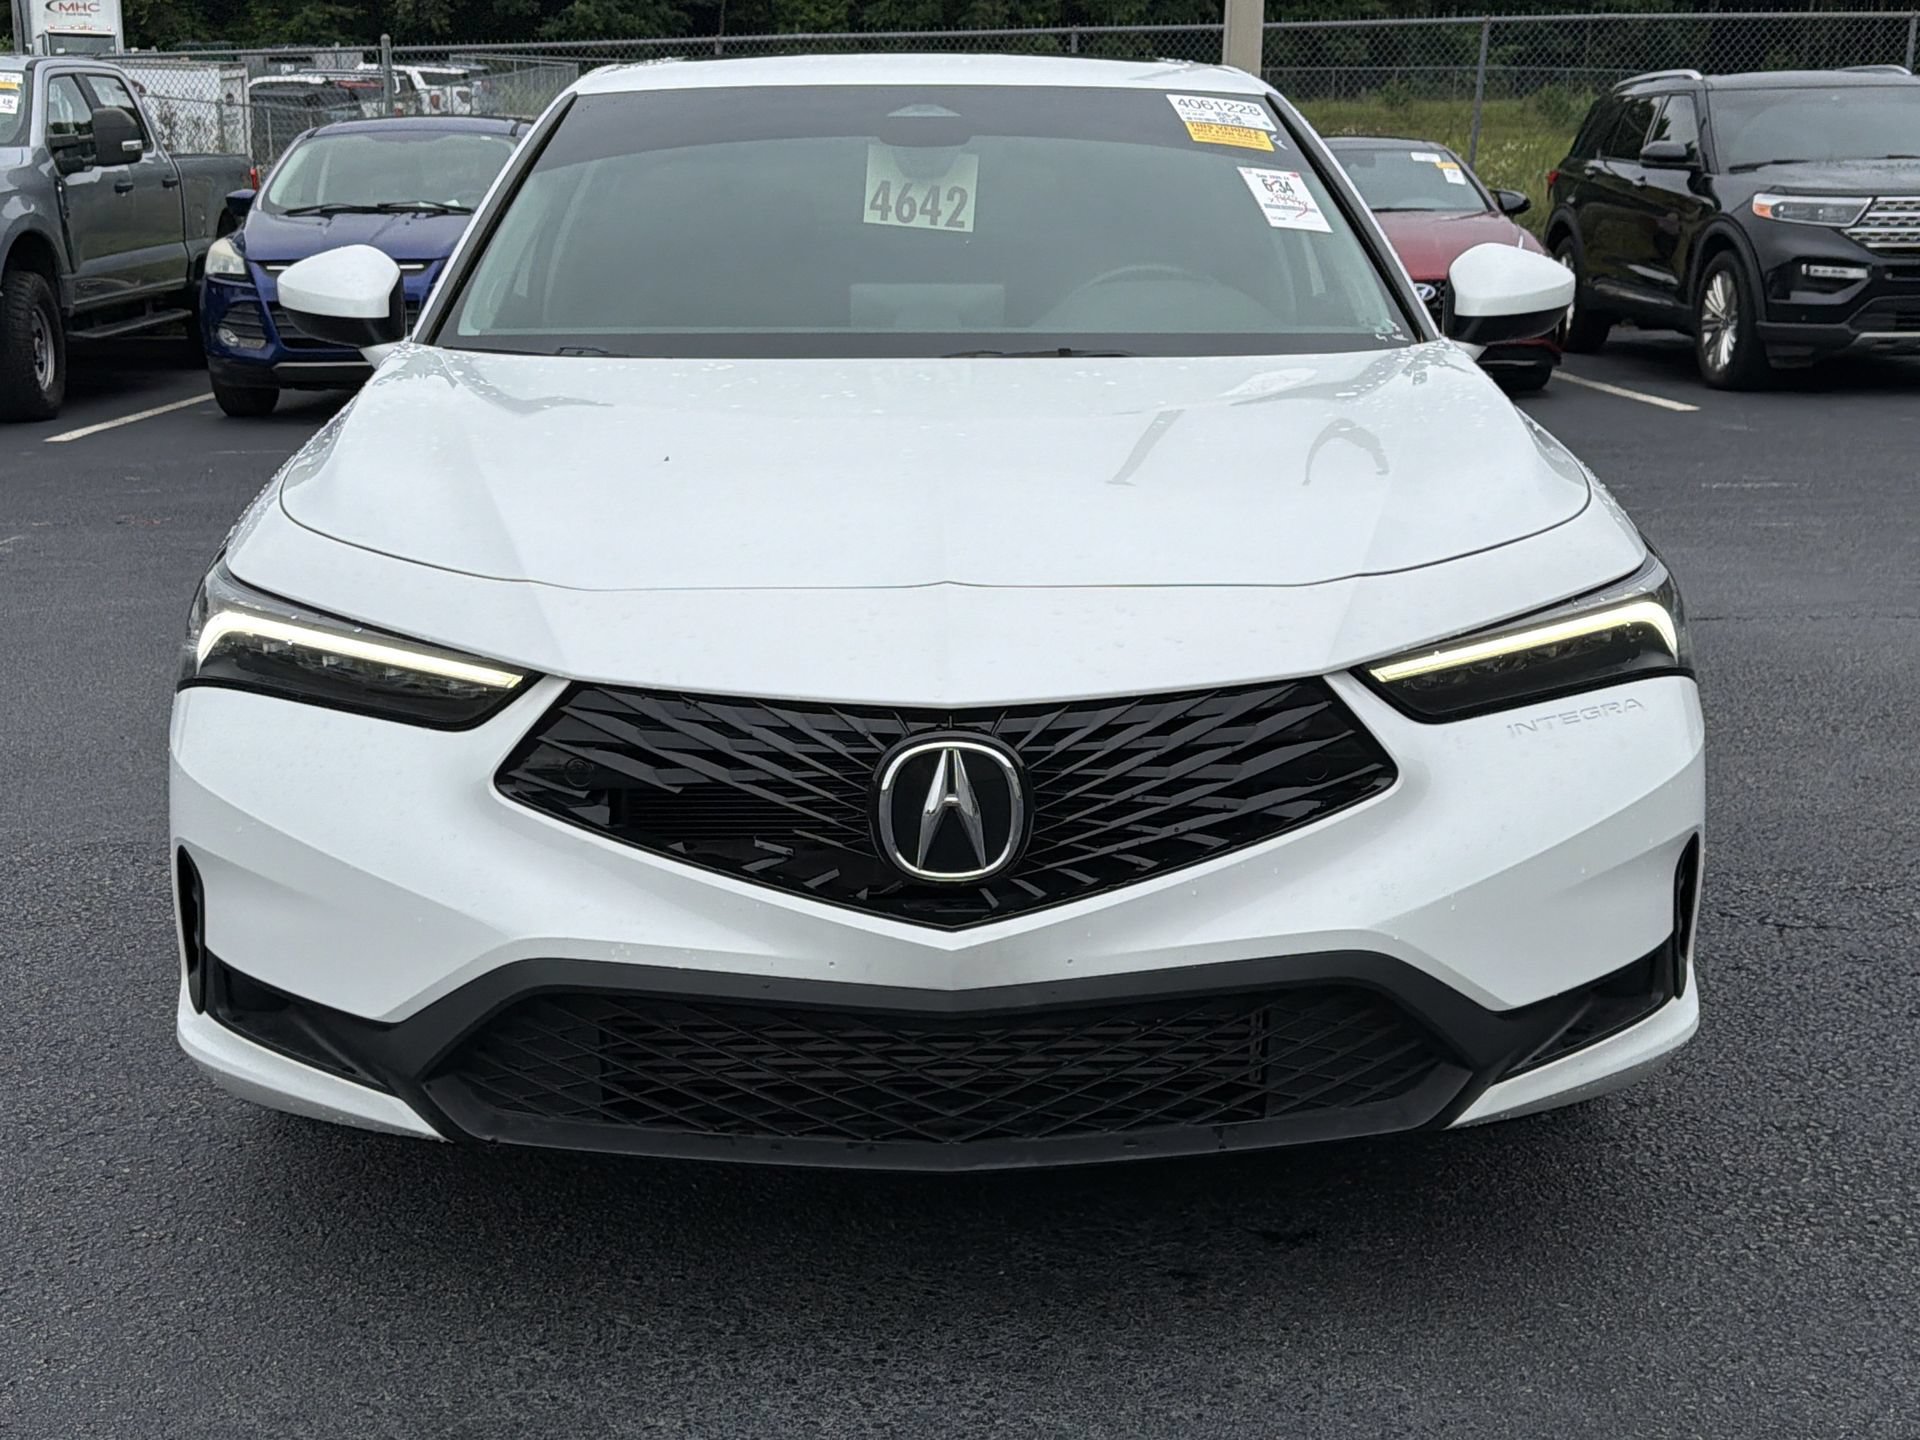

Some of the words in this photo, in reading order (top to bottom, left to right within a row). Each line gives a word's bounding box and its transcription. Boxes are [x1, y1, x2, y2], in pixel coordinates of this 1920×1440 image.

[58, 2, 101, 13] MHC
[869, 179, 969, 229] 4642
[1506, 698, 1647, 738] INTEGRA
